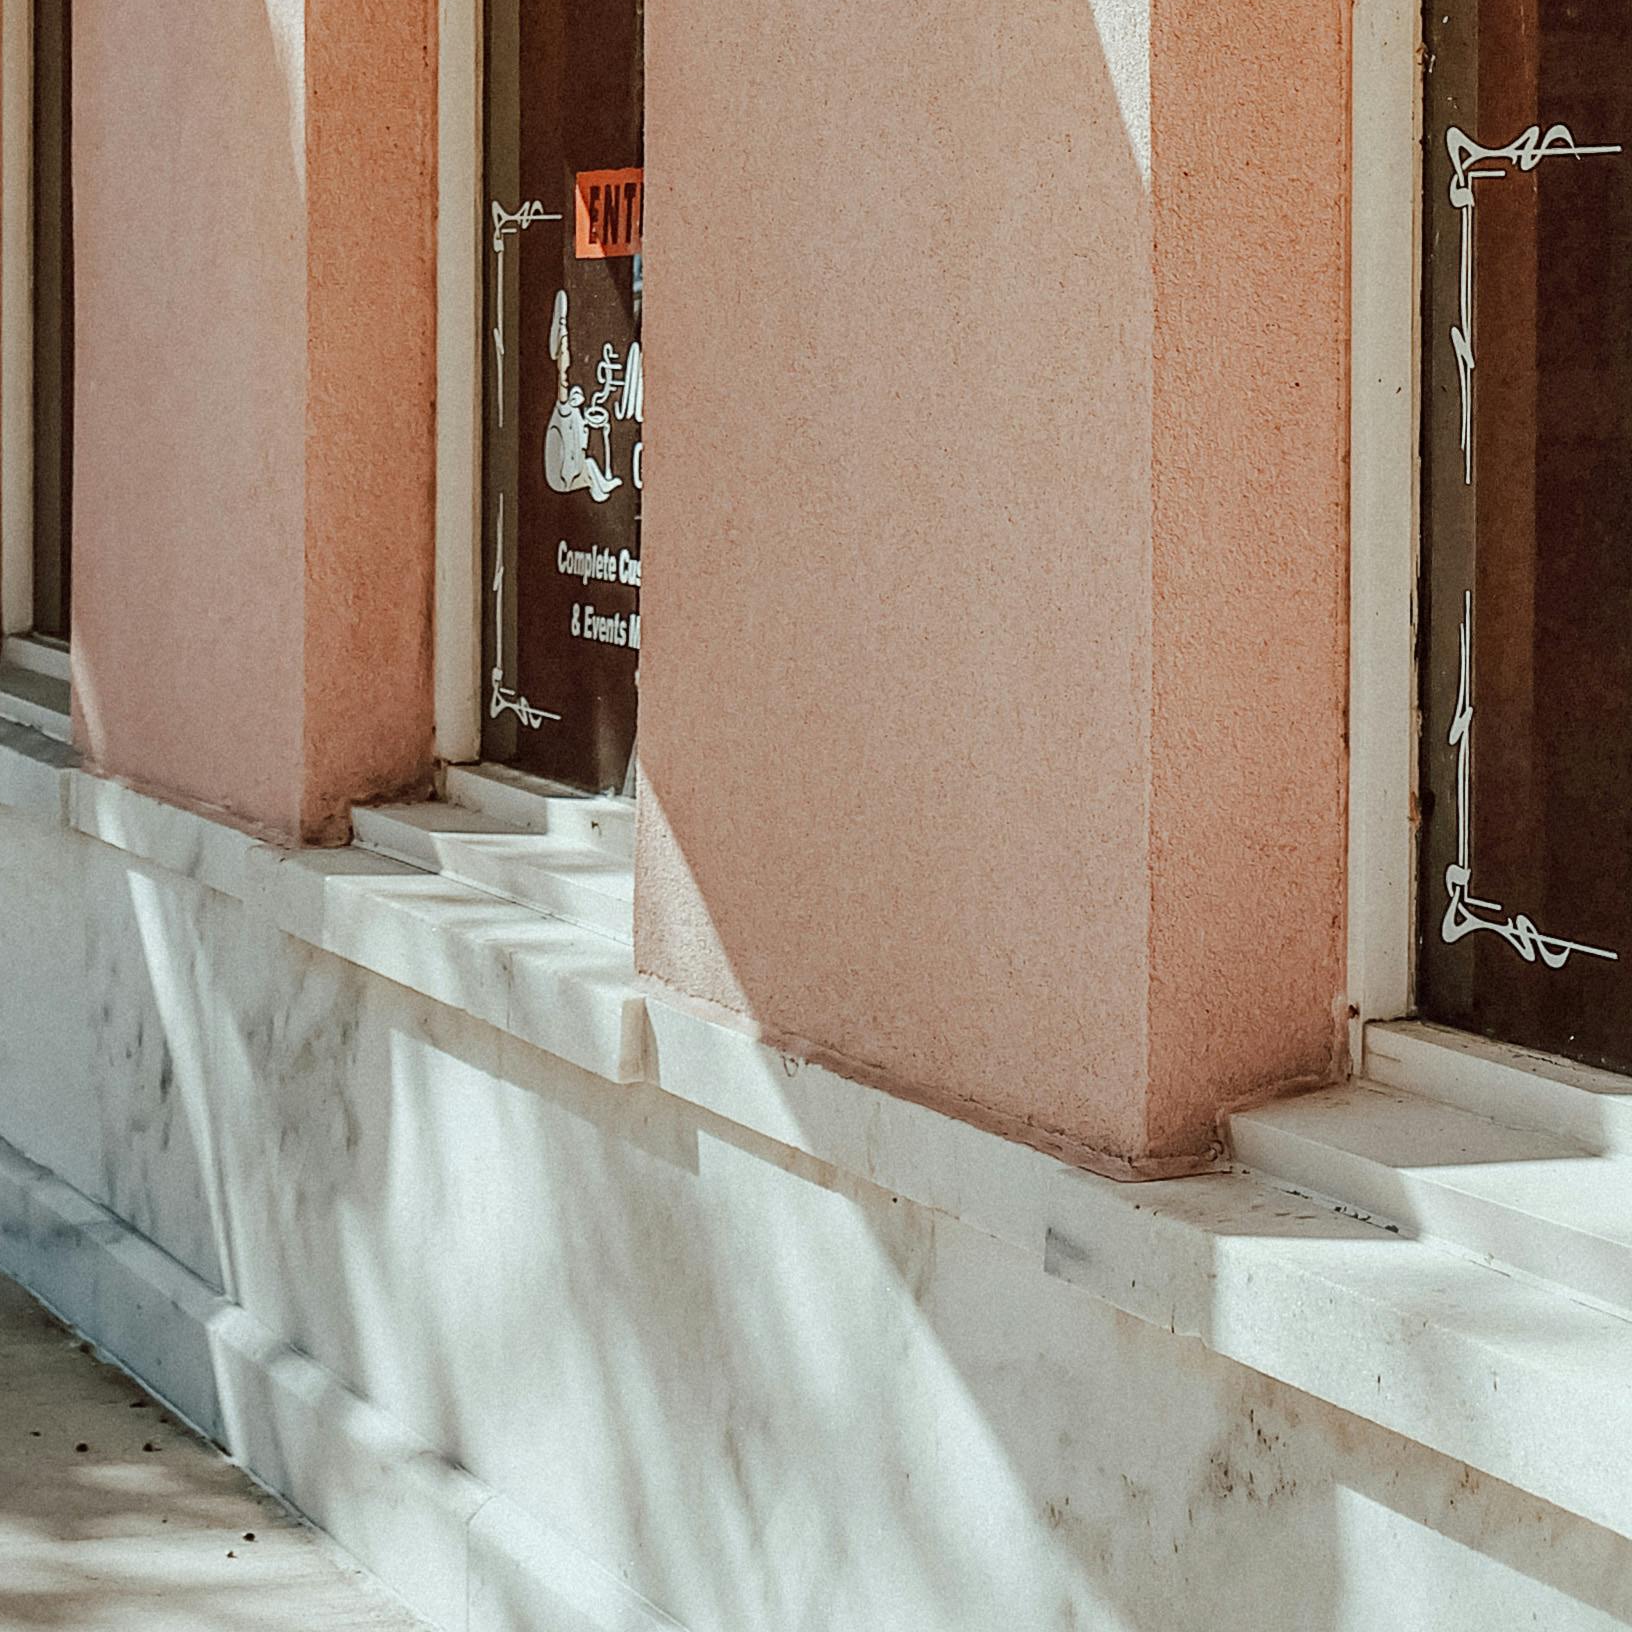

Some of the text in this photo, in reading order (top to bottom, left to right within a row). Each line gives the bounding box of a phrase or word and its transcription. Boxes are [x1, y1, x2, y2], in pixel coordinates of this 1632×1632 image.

[557, 540, 617, 586] Complete
[571, 603, 580, 637] &
[583, 605, 627, 647] Events
